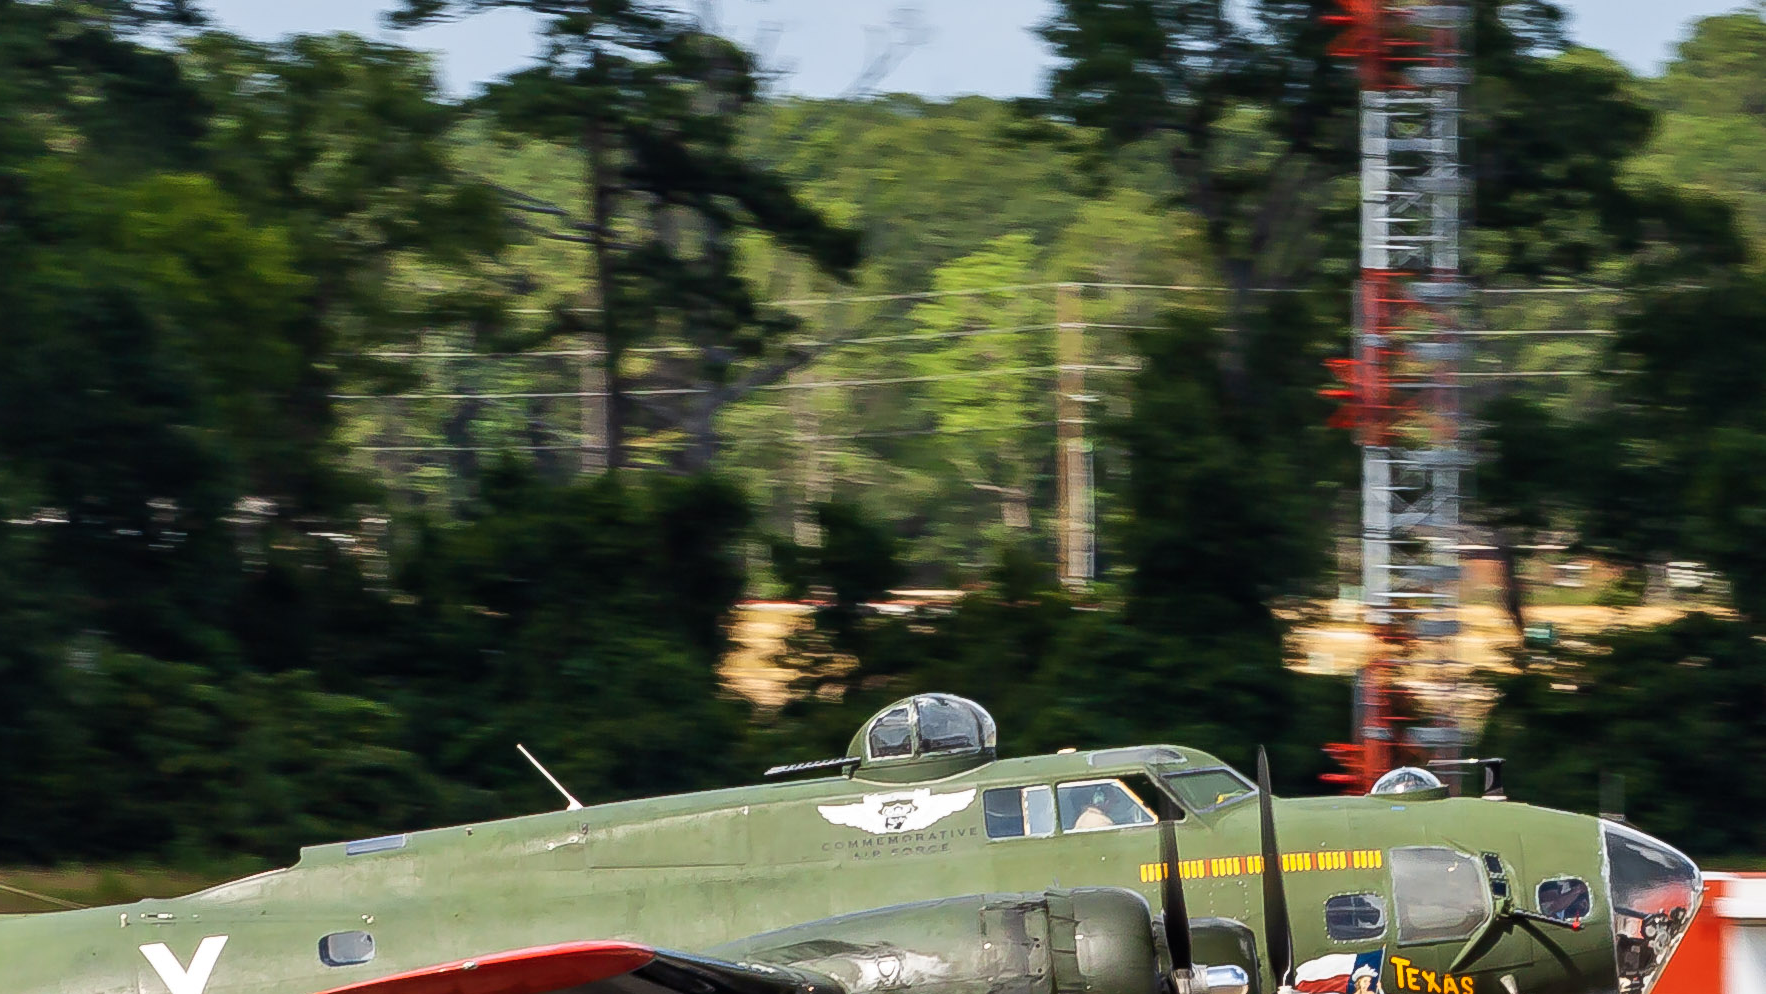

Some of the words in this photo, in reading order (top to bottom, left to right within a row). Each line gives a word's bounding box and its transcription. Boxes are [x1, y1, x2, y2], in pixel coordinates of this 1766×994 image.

[821, 826, 978, 851] COMMEMORATIVE
[854, 849, 881, 860] AIR
[890, 843, 950, 857] FORCE
